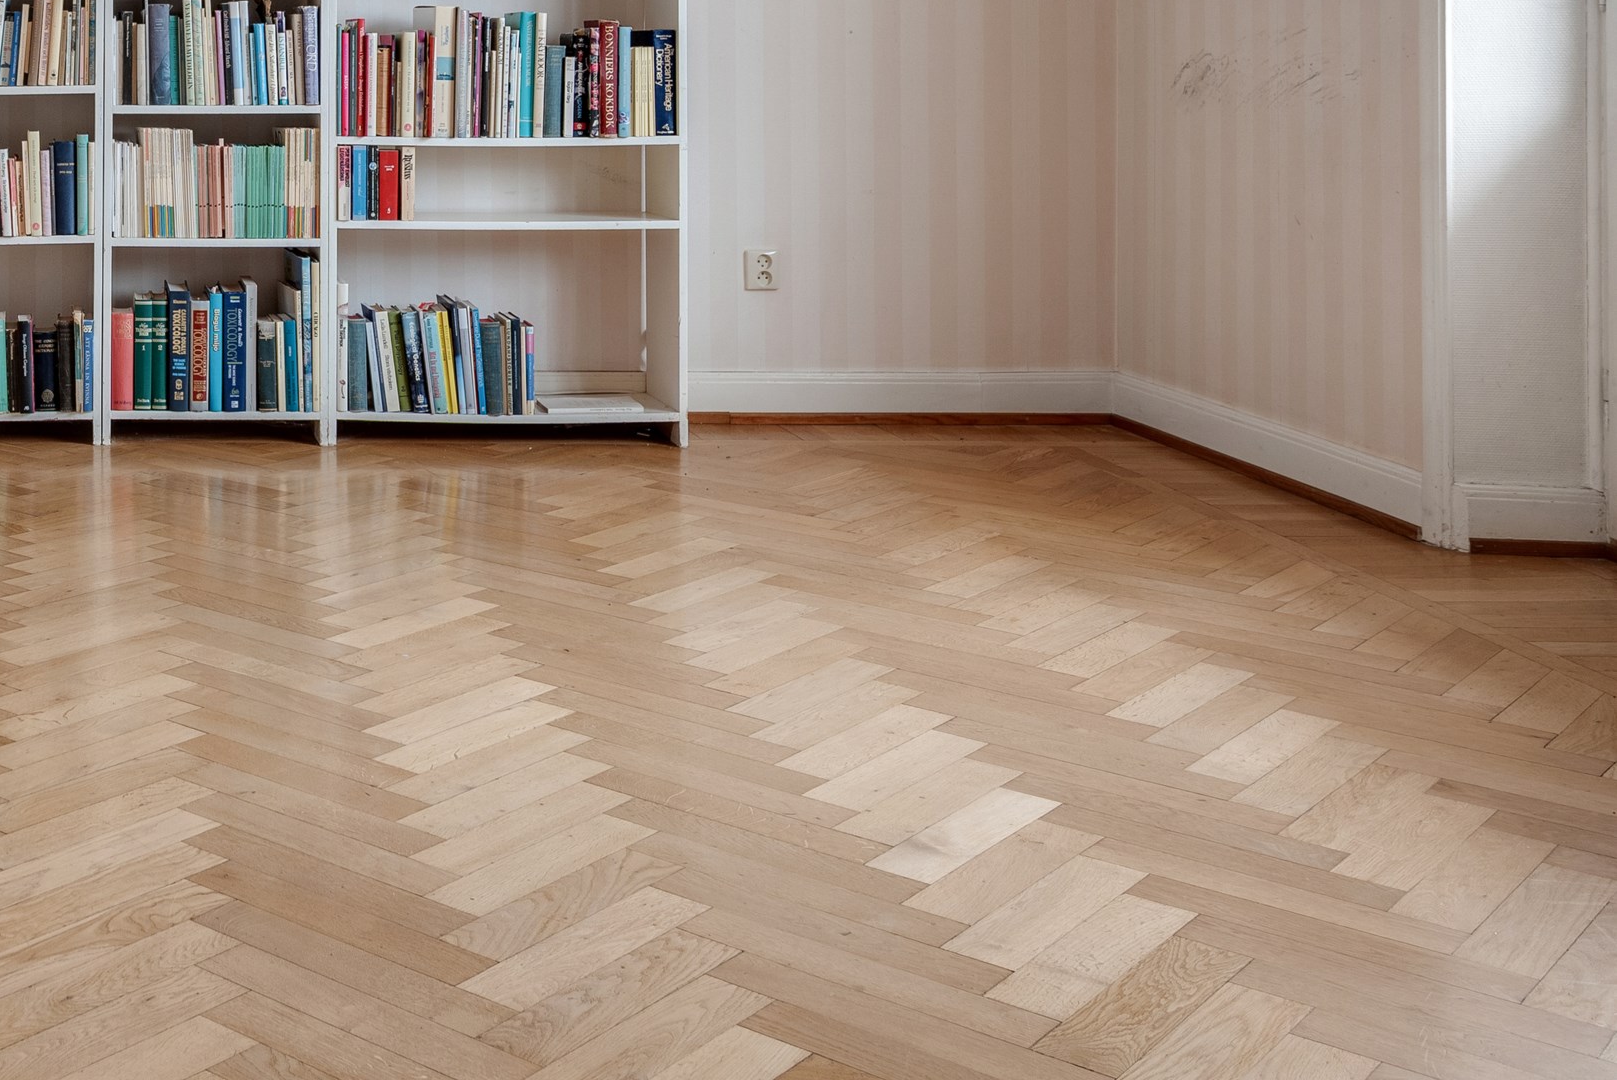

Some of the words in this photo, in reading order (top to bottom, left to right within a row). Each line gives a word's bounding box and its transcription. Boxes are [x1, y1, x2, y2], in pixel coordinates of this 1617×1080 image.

[278, 36, 287, 73] ISTANBUL
[305, 44, 318, 72] ORD
[536, 36, 545, 79] KRYDDOR
[604, 25, 615, 80] BONNIERS
[654, 48, 665, 87] Dictionary
[663, 42, 674, 78] American
[604, 82, 615, 128] KOKBOK
[663, 79, 675, 112] Heritage
[172, 310, 182, 355] TOXICOLOGY
[226, 308, 239, 363] TOXICOLOGY
[407, 321, 420, 354] Ecological
[193, 329, 203, 376] TOXICOLOGY
[411, 354, 423, 382] Genetics
